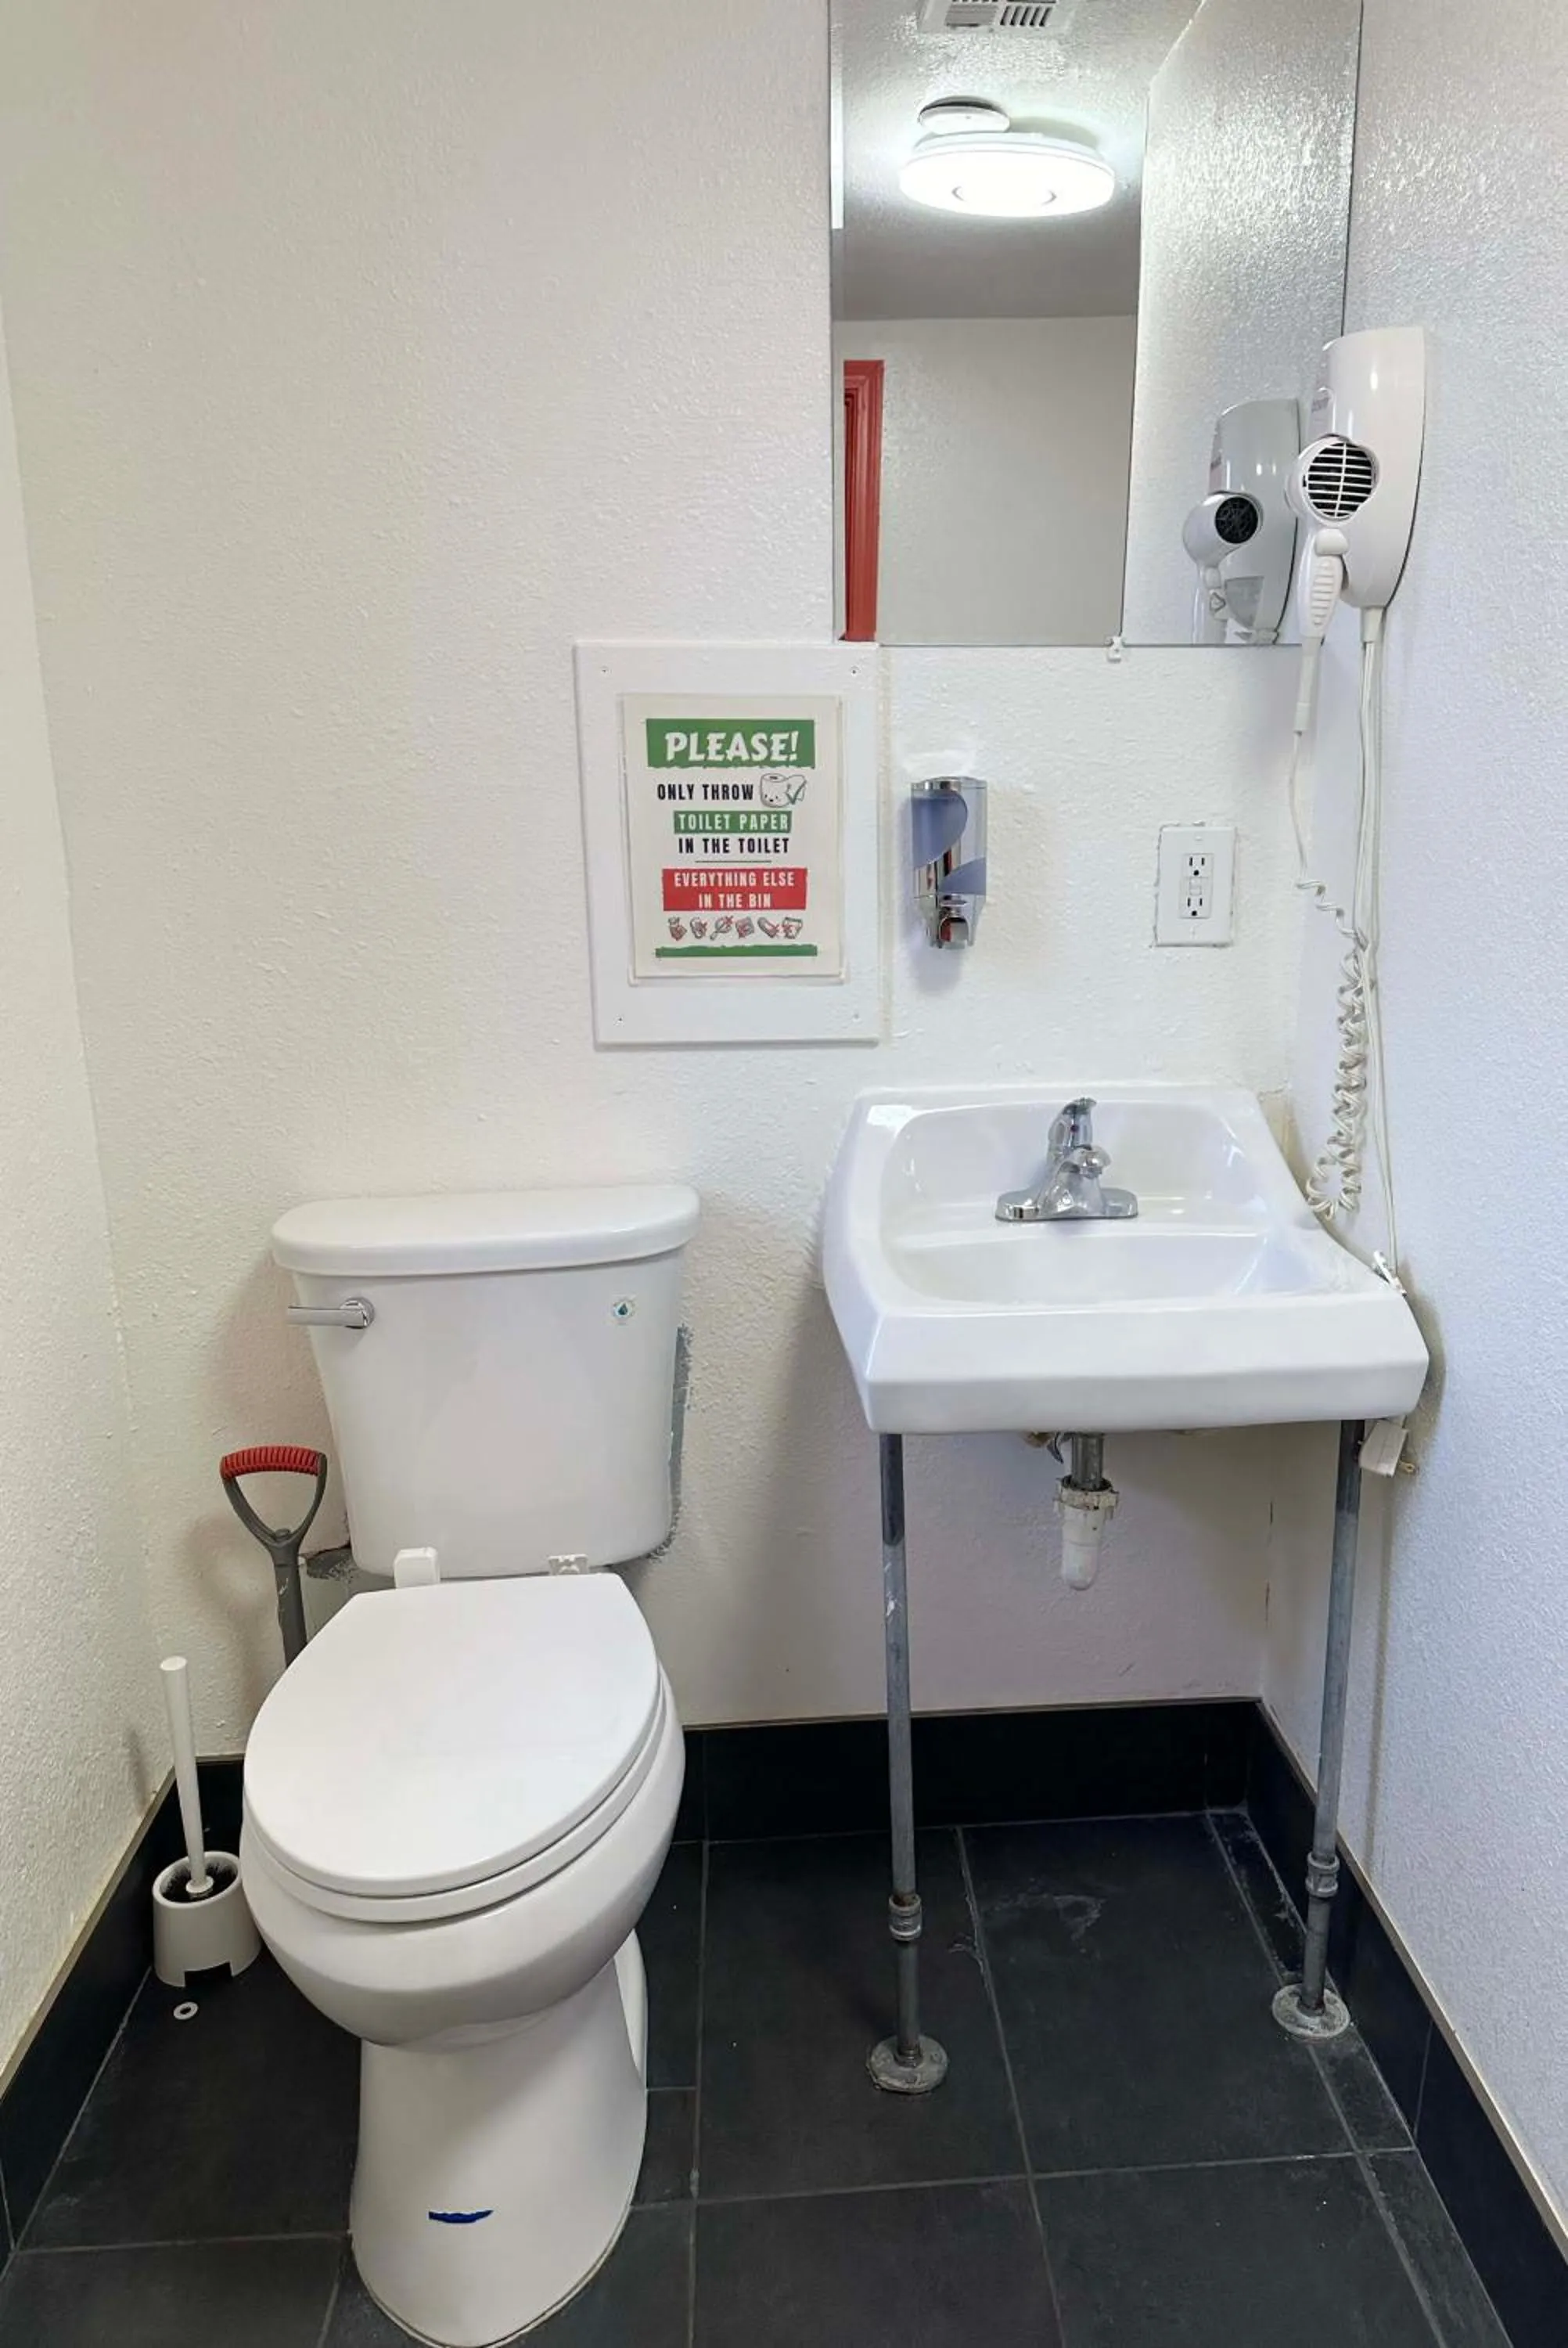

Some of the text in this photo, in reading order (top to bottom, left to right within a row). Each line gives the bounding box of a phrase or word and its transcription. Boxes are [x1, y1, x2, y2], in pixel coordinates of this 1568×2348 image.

[665, 731, 799, 762] PLEASE!
[657, 784, 753, 801] ONLY THROW
[679, 814, 789, 830] TOILET PAPER
[678, 837, 789, 854] IN THE TOILET
[674, 871, 795, 887] EVERYTHING ELSE
[699, 894, 771, 909] IN THE BIN
